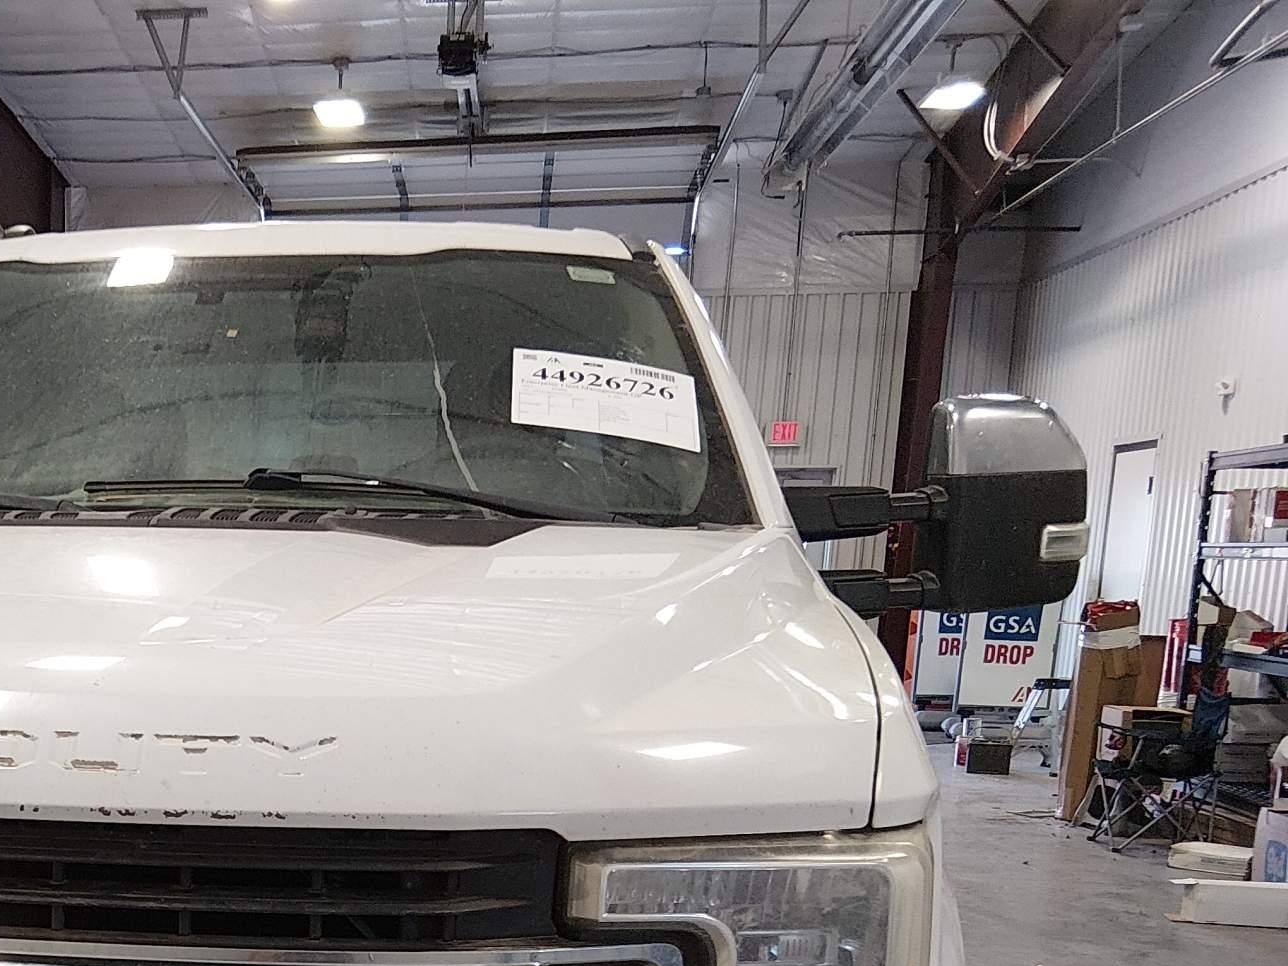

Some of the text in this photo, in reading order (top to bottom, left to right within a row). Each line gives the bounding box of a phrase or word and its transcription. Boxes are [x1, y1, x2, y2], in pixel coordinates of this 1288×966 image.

[532, 367, 675, 400] 44926726
[773, 423, 798, 440] EXIT
[989, 615, 1036, 634] GSA
[938, 637, 961, 656] DR
[983, 643, 1035, 665] DROP
